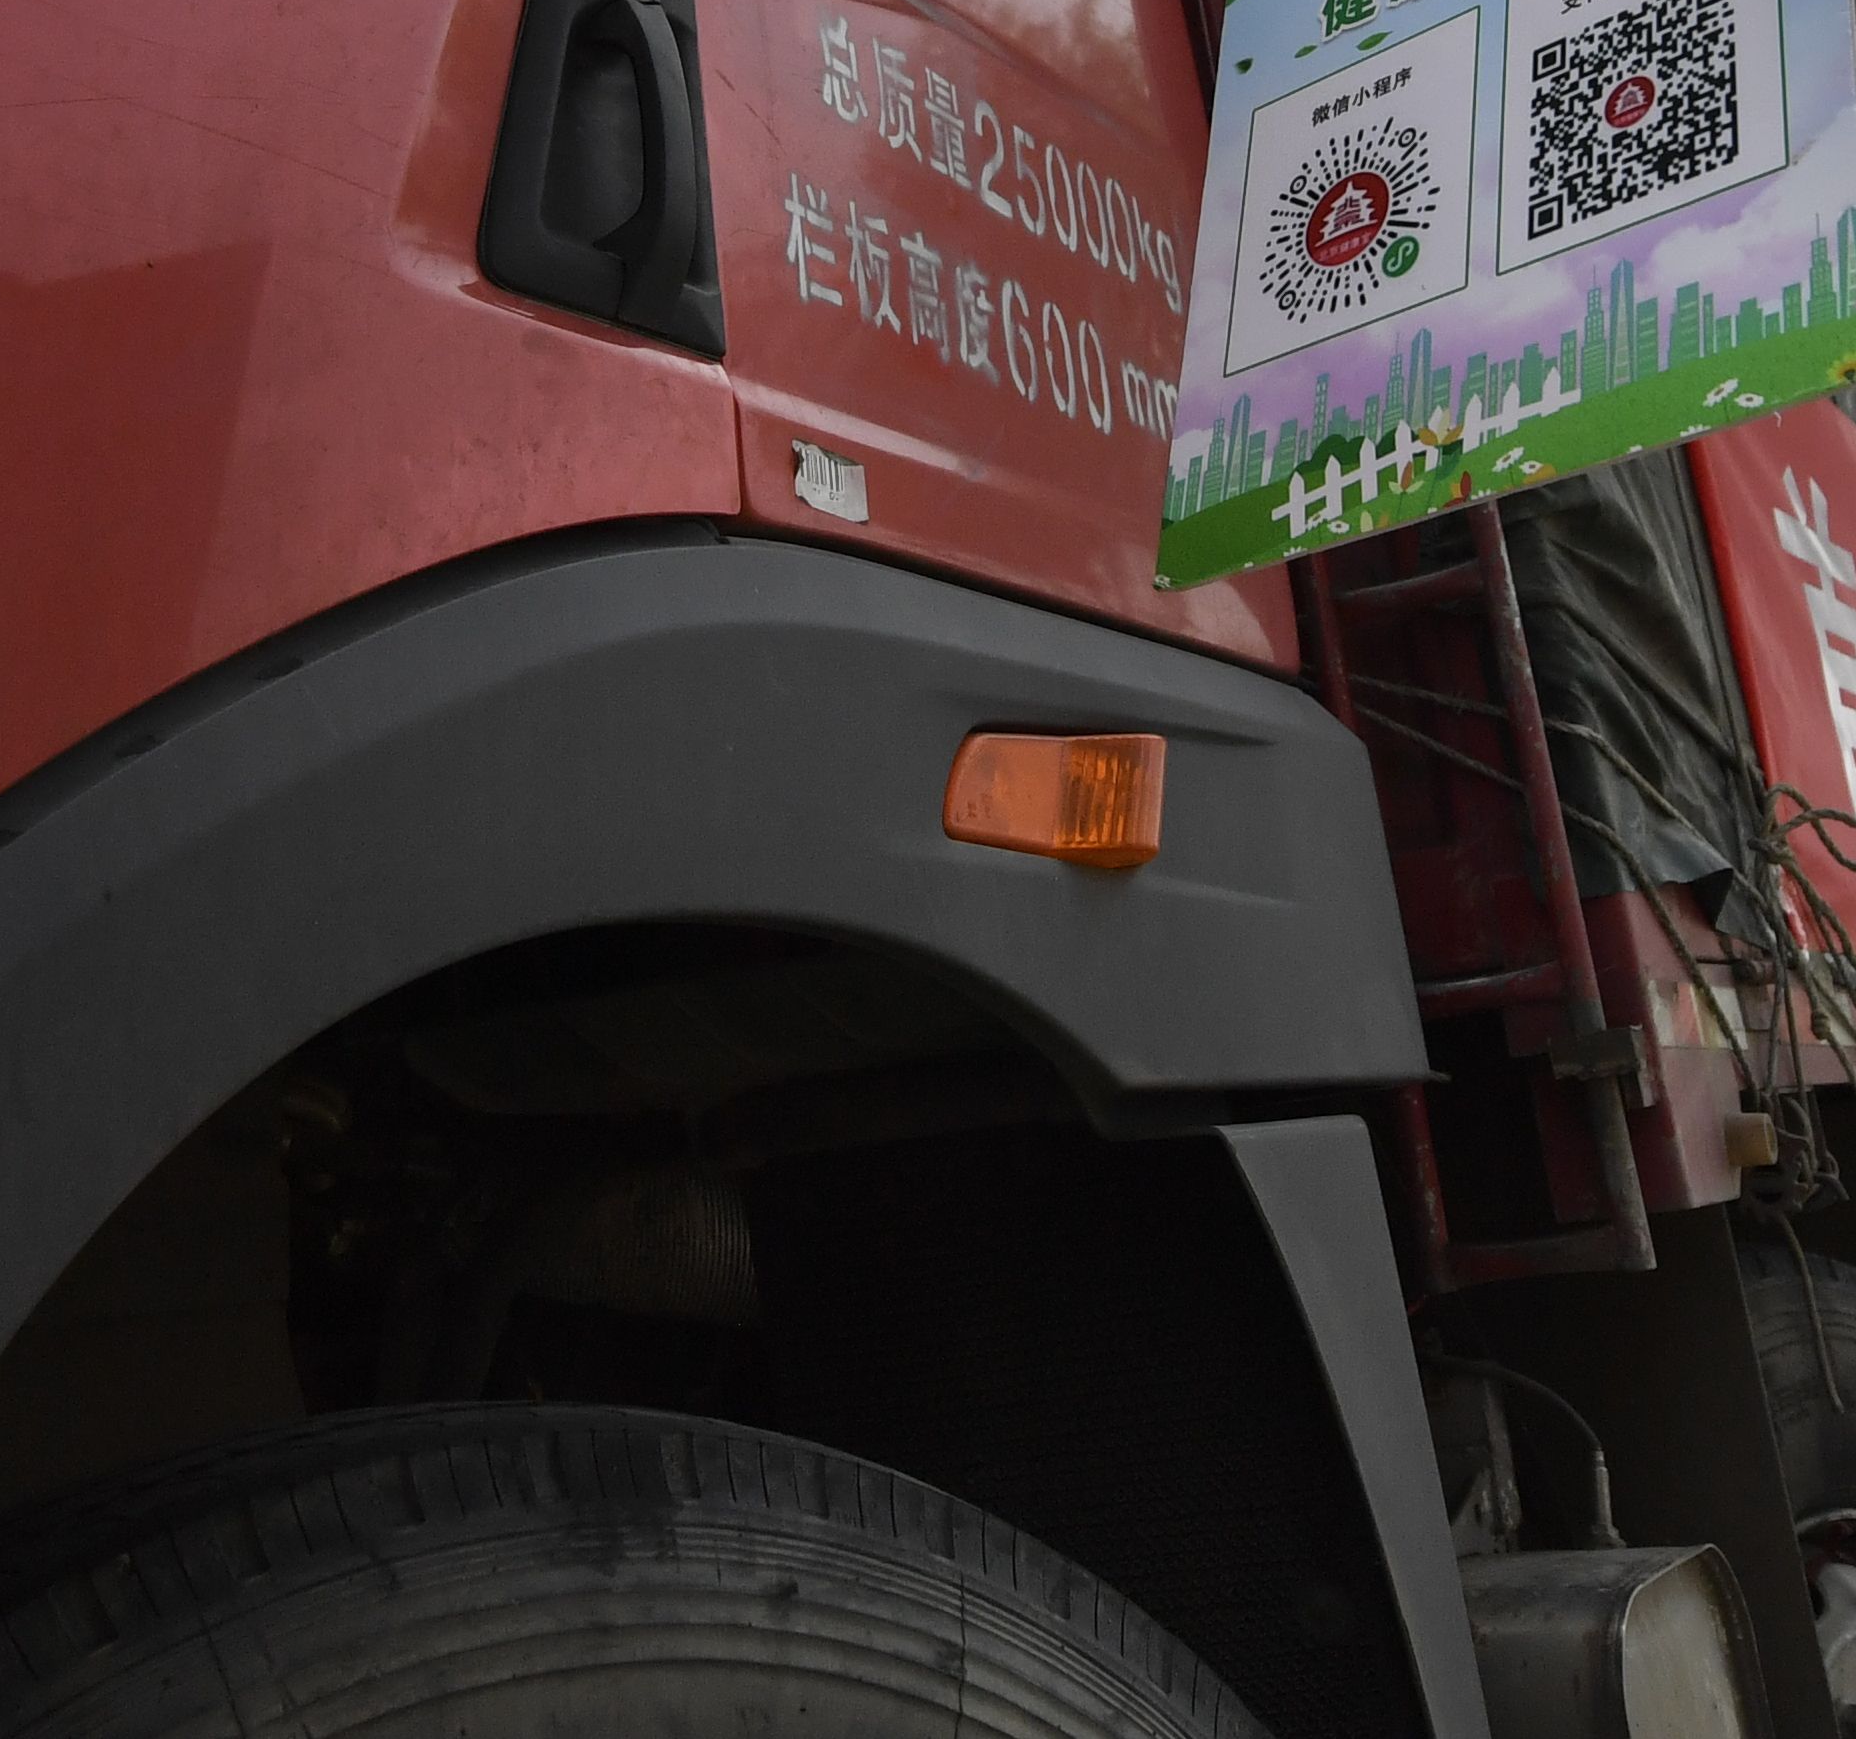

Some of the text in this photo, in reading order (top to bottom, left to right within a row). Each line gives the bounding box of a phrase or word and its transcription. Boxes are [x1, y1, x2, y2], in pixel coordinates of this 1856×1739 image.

[819, 15, 1183, 316] 总质量25000kg
[1311, 65, 1414, 128] 微信小程序
